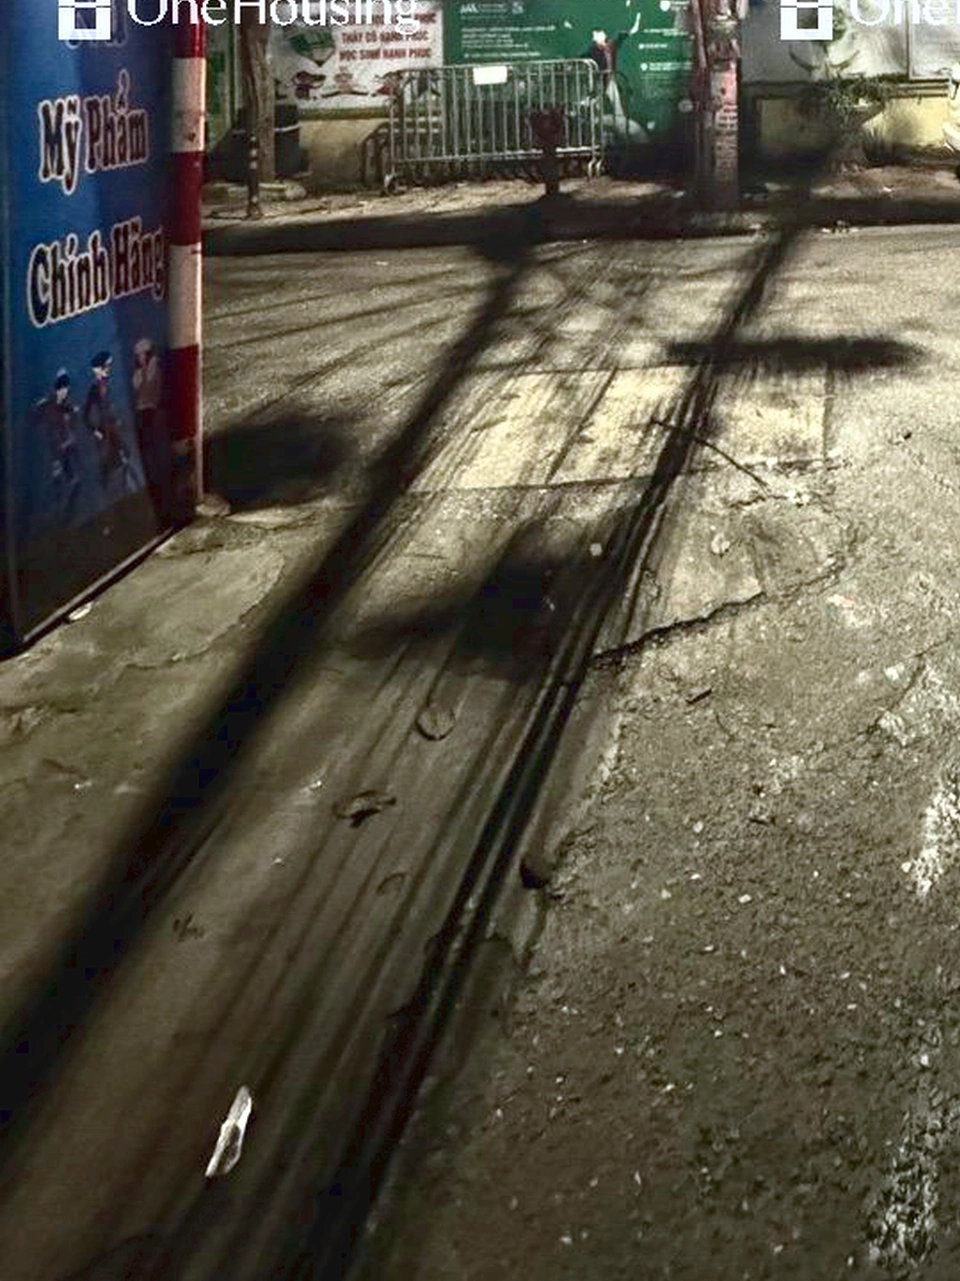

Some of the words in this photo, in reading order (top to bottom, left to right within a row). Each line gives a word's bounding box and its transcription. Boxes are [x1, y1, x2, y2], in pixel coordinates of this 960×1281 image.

[38, 94, 81, 195] Mỹ
[83, 69, 148, 173] Phẩm
[27, 228, 110, 328] Chính
